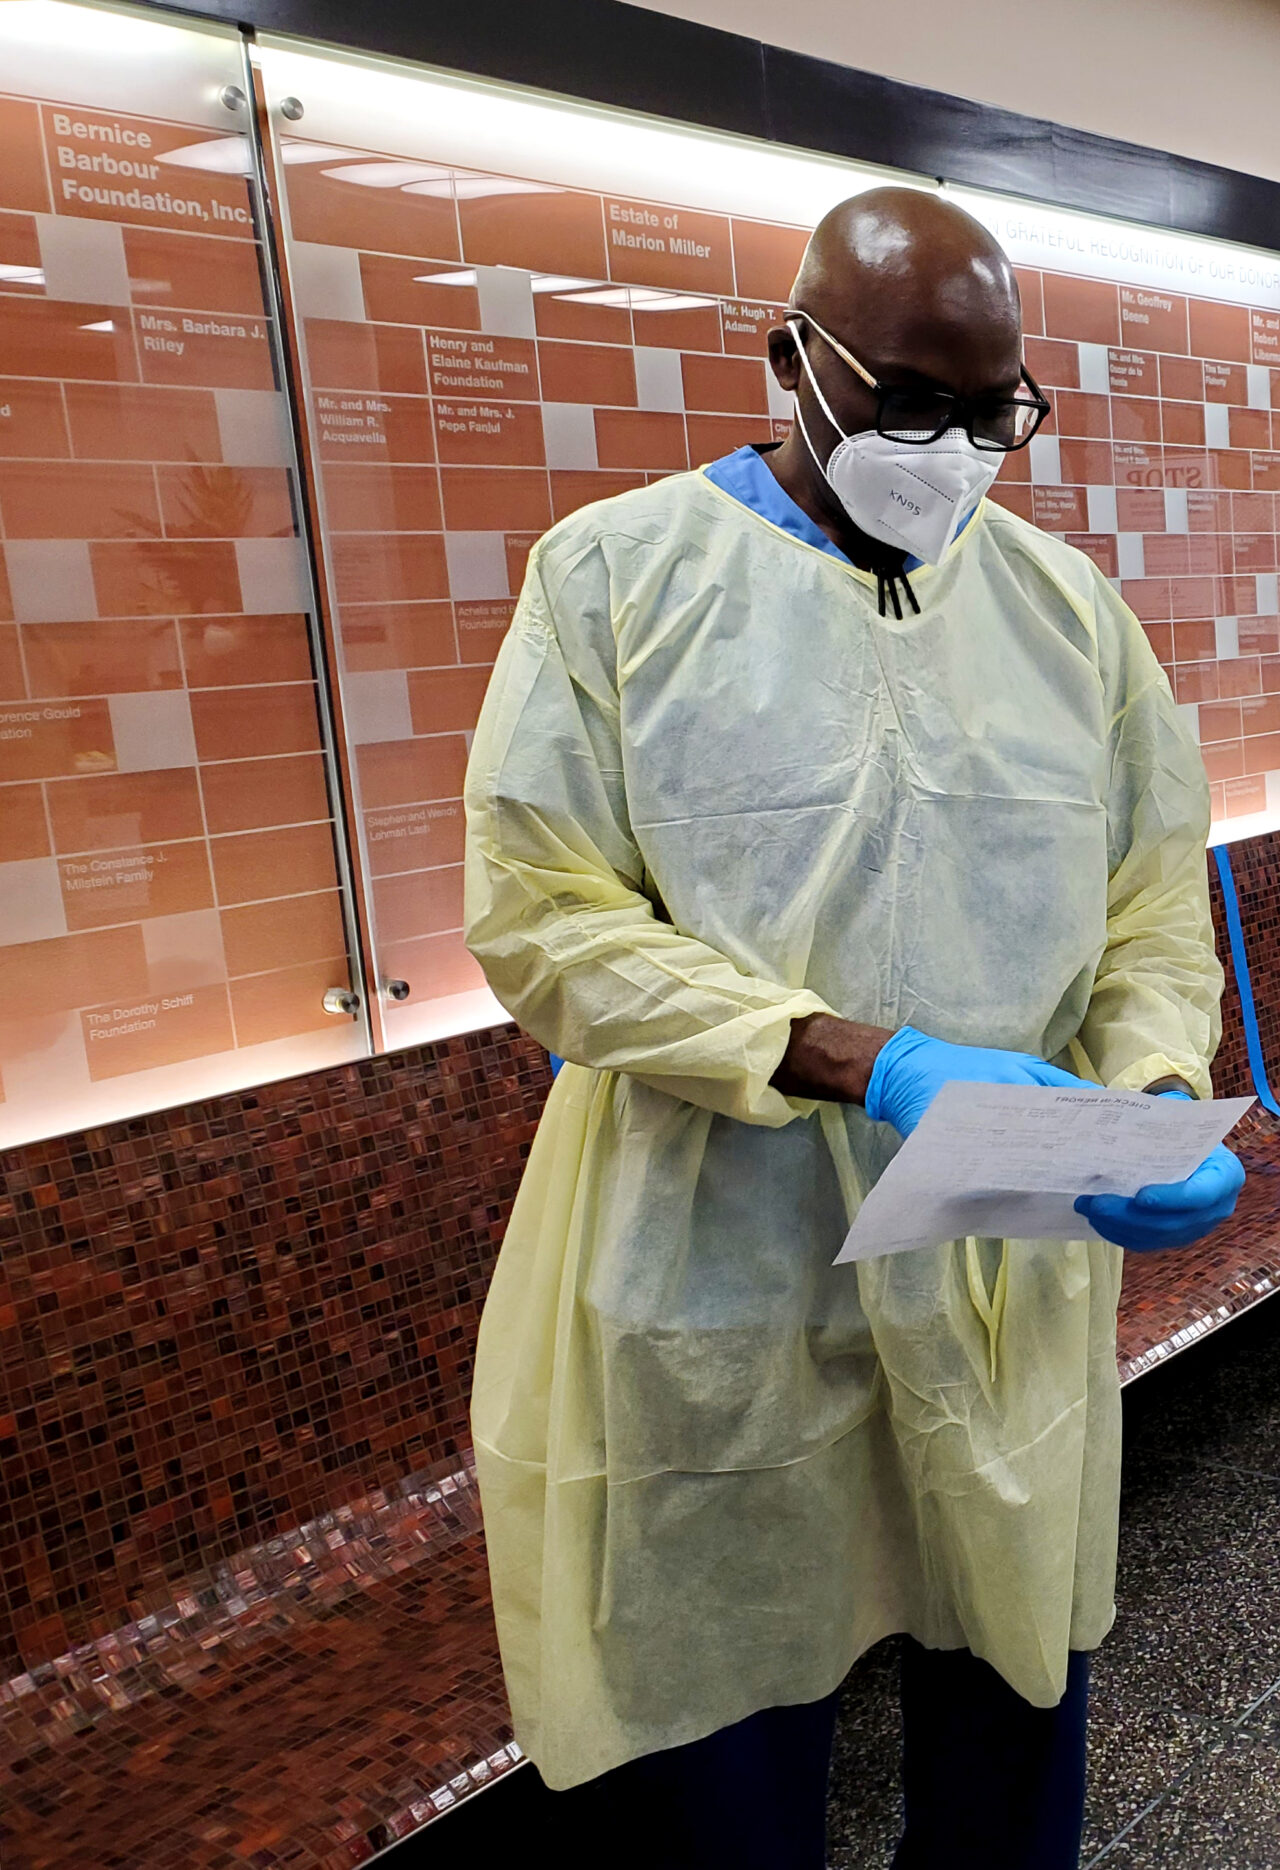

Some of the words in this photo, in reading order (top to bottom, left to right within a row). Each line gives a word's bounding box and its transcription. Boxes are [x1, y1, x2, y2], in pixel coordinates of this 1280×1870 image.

[53, 113, 152, 148] Bernice
[57, 145, 160, 180] Barbour
[62, 178, 209, 222] Foundation,
[212, 199, 254, 223] Inc.
[609, 204, 659, 227] Estate
[663, 214, 679, 230] of
[612, 229, 665, 252] Marion
[669, 237, 711, 258] Miller
[1006, 218, 1085, 253] GRATEFUL
[1090, 238, 1184, 271] RECOGNITION
[1188, 254, 1204, 275] OF
[1208, 260, 1235, 281] OUR
[723, 302, 738, 316] Mr.
[741, 305, 765, 321] Hugh
[767, 309, 776, 320] T.
[1121, 290, 1136, 304] Mr.
[1137, 293, 1172, 312] Geoffrey
[140, 315, 177, 332] Mrs.
[182, 318, 246, 337] Barbara
[251, 325, 265, 339] J.
[725, 320, 757, 334] Adams
[1266, 319, 1280, 330] and
[144, 336, 184, 355] Riley
[429, 335, 467, 353] Henry
[471, 341, 494, 353] and
[431, 354, 471, 369] Elaine
[474, 357, 529, 374] Kaufman
[433, 372, 504, 389] Foundation
[318, 397, 338, 409] Mr.
[341, 399, 363, 411] and
[366, 400, 392, 412] Mrs.
[437, 404, 455, 415] Mr.
[457, 406, 477, 417] and
[480, 406, 503, 418] Mrs.
[505, 408, 516, 419] J.
[320, 413, 364, 426] William
[366, 416, 380, 427] R.
[439, 420, 467, 432] Pepe
[469, 421, 501, 434] Fanjul
[323, 429, 387, 444] Acquavella
[889, 489, 921, 516] KN95
[459, 620, 507, 630] Foundation
[43, 704, 81, 720] Gould
[367, 814, 407, 828] Stephen
[408, 810, 426, 822] and
[427, 806, 457, 819] Wendy
[63, 863, 88, 876] The
[90, 855, 154, 872] Constance
[156, 851, 168, 863] J.
[65, 875, 115, 891] Milstein
[115, 869, 154, 885] Family
[86, 1014, 111, 1025] The
[113, 1003, 159, 1021] Dorothy
[162, 993, 195, 1010] Schiff
[90, 1019, 156, 1041] Foundation
